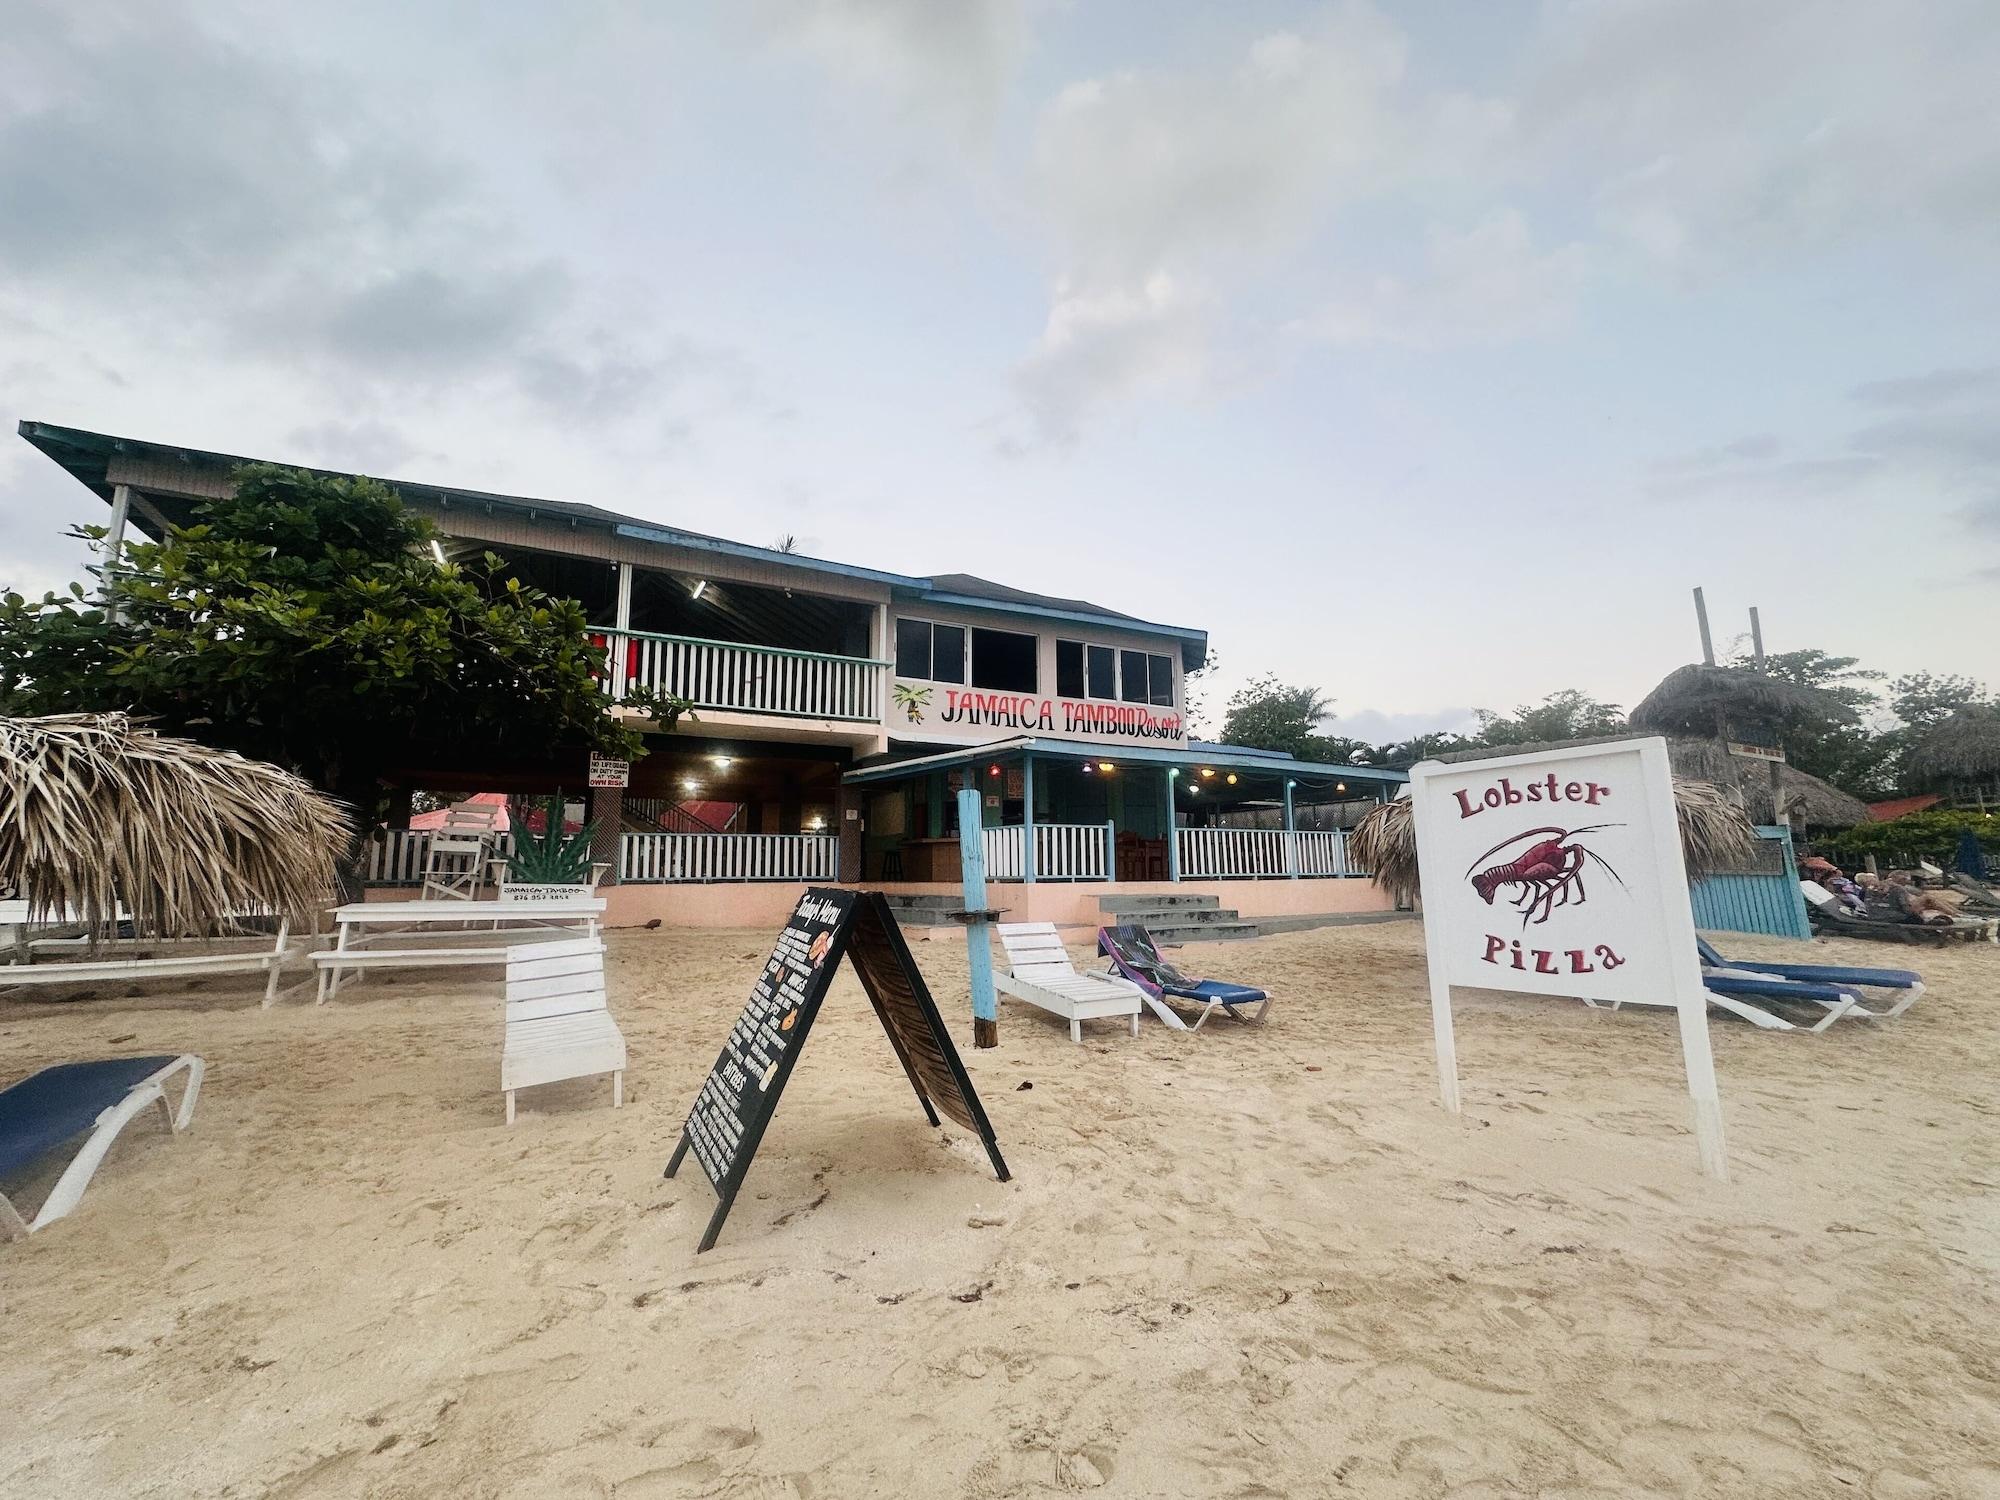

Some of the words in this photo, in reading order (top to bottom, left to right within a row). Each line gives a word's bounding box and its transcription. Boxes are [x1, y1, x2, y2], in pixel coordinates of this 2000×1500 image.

[941, 690, 1054, 731] JAMAICA
[1061, 702, 1136, 736] TAMBOO
[1135, 707, 1184, 741] Resort
[1452, 773, 1611, 819] Lobster
[815, 899, 842, 926] Menu
[1481, 934, 1626, 974] Pizza
